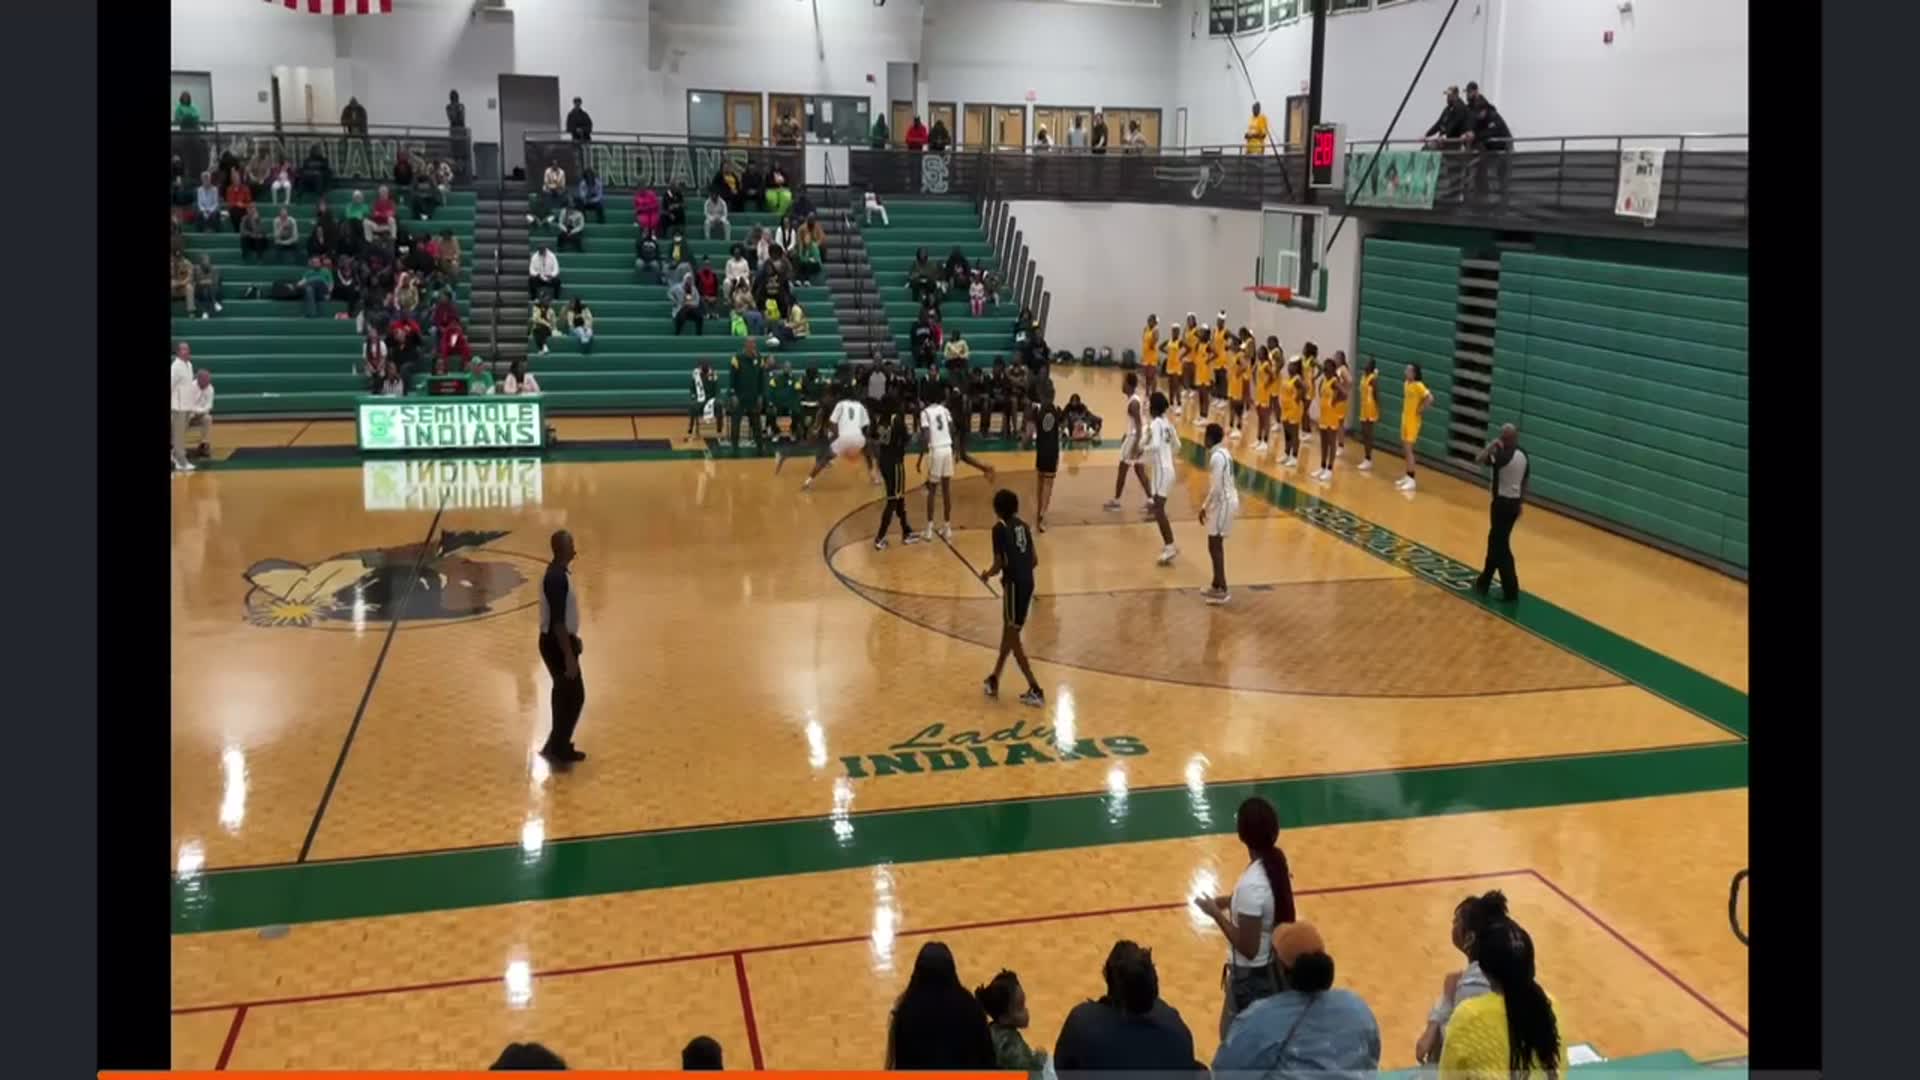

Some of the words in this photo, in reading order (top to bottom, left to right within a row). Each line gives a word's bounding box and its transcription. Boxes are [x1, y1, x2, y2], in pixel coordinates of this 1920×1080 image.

[401, 405, 533, 424] SEMINOLE
[404, 424, 535, 446] INDIANS
[888, 720, 1057, 750] Lady
[839, 735, 1150, 778] INDIANS
